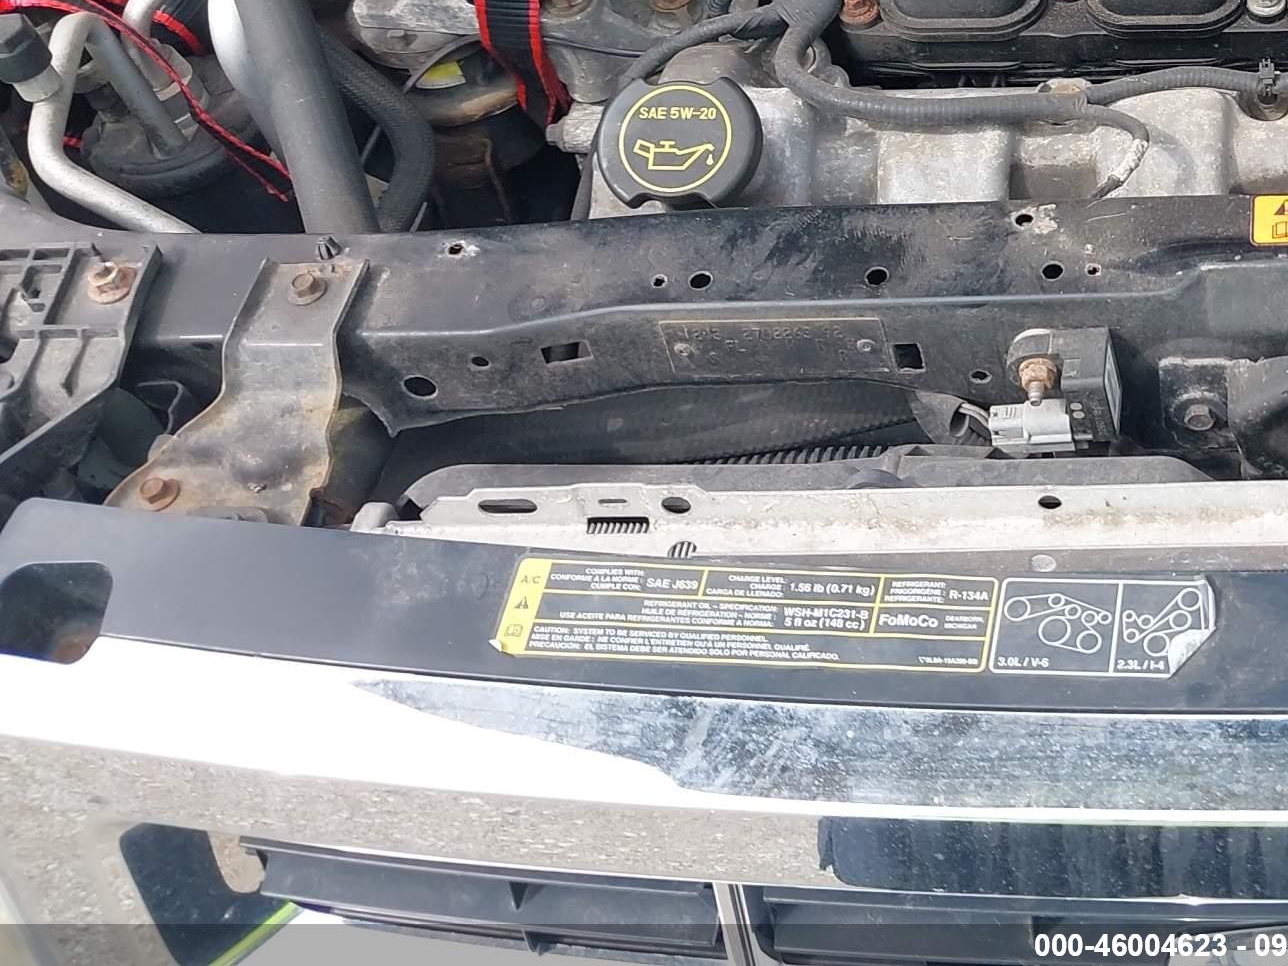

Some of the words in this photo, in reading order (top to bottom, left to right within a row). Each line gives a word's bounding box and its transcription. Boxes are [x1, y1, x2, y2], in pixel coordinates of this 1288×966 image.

[639, 107, 668, 120] SAE
[669, 106, 717, 120] 5W-20
[521, 575, 541, 584] A/C
[646, 577, 671, 589] SAE
[728, 575, 761, 583] CHARGE
[706, 588, 734, 596] CARGA
[734, 589, 745, 597] DE
[749, 583, 782, 591] CHARGE
[790, 583, 812, 593] 1.56
[813, 583, 825, 593] lb
[826, 583, 853, 594] (0.71
[856, 585, 875, 596] kg)
[949, 589, 989, 601] R-134A
[643, 600, 697, 609] REFRIGERANT
[783, 617, 792, 627] 5
[794, 617, 803, 627] fl
[803, 619, 818, 628] oz
[819, 617, 844, 629] (148
[845, 620, 865, 631] cc)
[878, 613, 938, 628] FoMoCo
[533, 626, 570, 634] CAUTION:
[573, 627, 605, 635] SYSTEM
[605, 628, 617, 636] TO
[617, 628, 629, 636] BE
[629, 629, 667, 638] SERVICED
[667, 631, 680, 639] BY
[680, 632, 721, 640] QUALIFIED
[997, 656, 1021, 667] 3.0L
[1031, 657, 1049, 668] V-6
[1116, 659, 1141, 670] 2.3L
[1150, 660, 1165, 670] I-4
